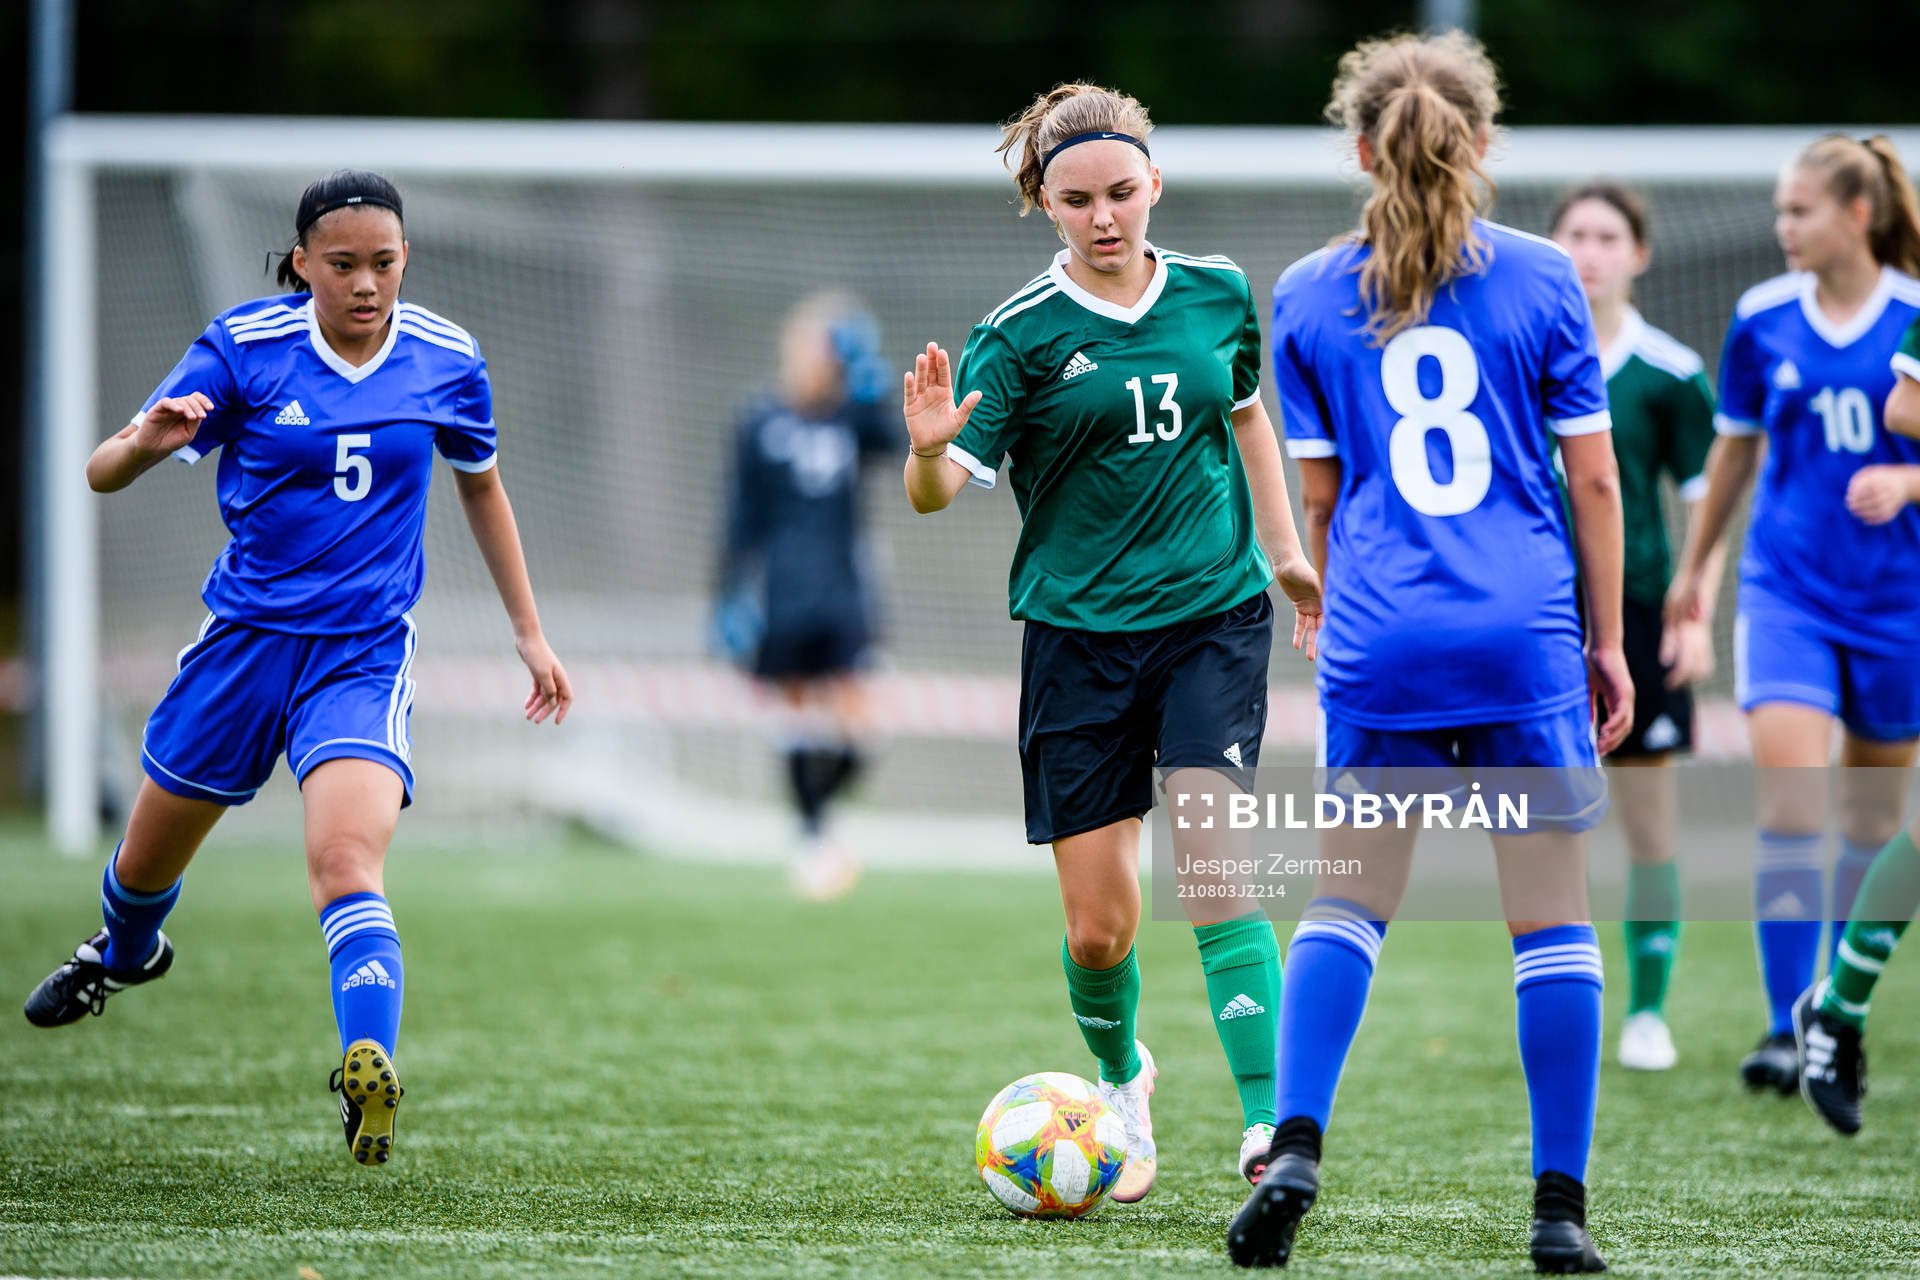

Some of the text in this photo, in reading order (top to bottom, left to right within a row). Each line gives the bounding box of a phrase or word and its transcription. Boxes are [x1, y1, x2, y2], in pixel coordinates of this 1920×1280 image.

[1062, 361, 1099, 381] adidas
[274, 415, 311, 426] adidas
[1125, 372, 1183, 444] 13
[1380, 325, 1493, 518] 8
[1809, 386, 1875, 453] 10
[333, 433, 373, 502] 5
[341, 974, 396, 992] adidas
[1218, 1005, 1265, 1021] adidas
